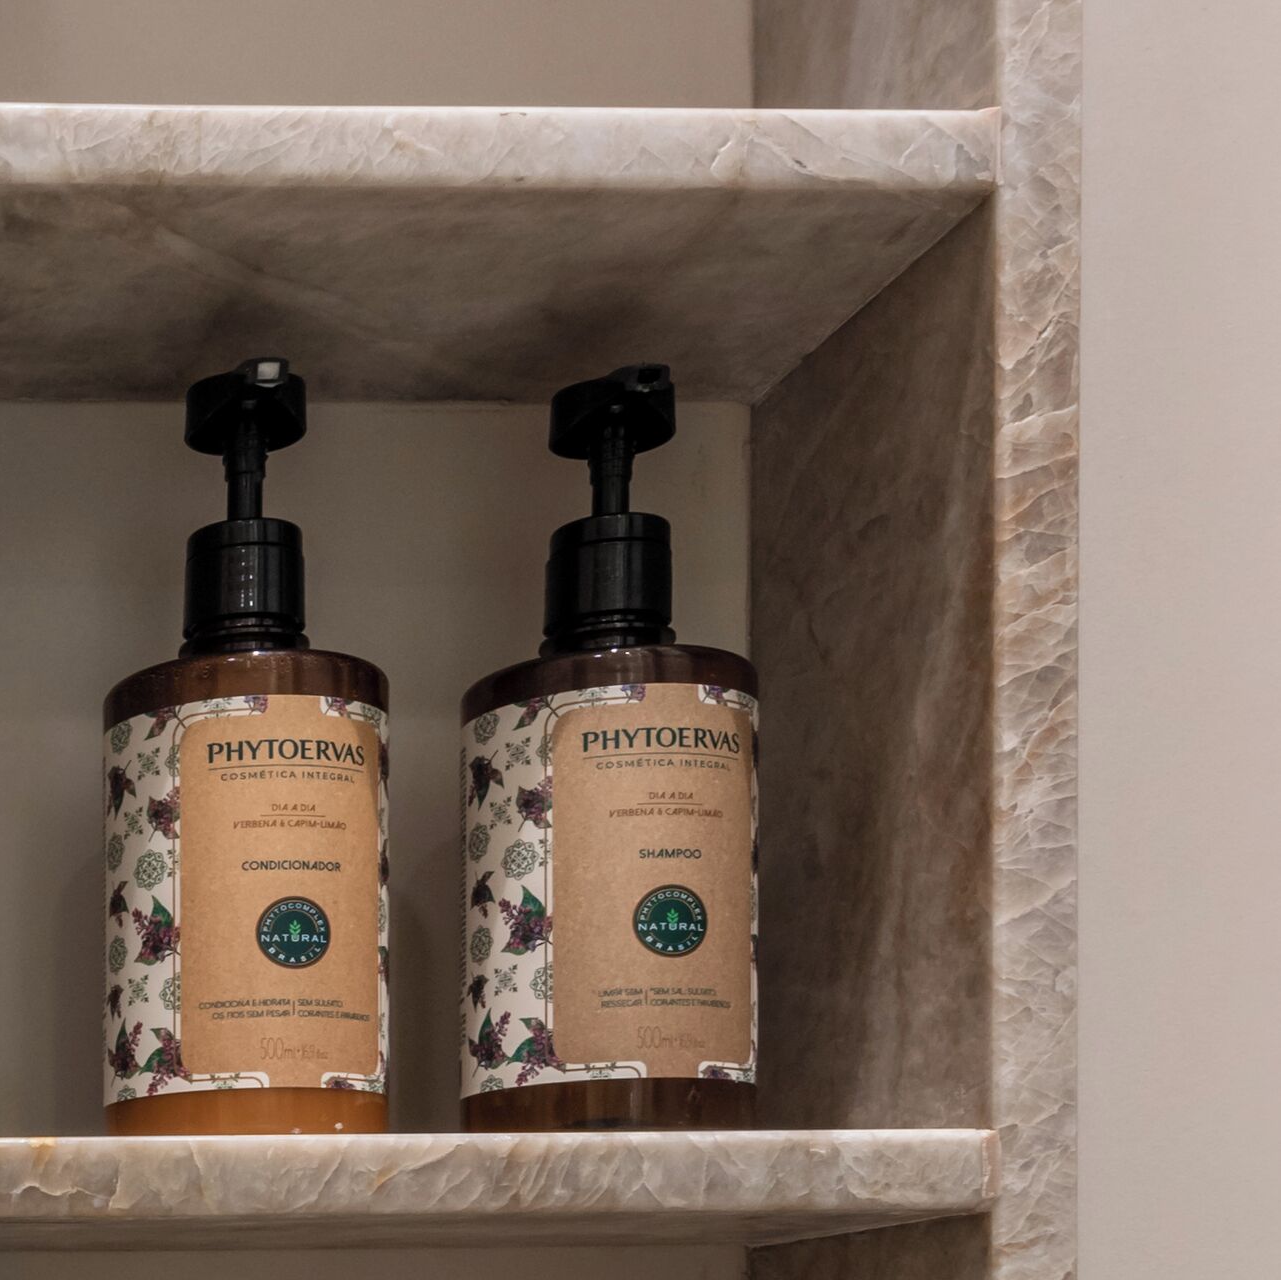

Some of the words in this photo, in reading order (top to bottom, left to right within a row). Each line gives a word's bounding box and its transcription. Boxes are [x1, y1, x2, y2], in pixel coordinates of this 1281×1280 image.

[582, 727, 740, 754] PHYTOERVAS
[207, 739, 365, 766] PHYTOERVAS
[596, 758, 674, 770] COSMÉTICA
[680, 759, 730, 771] INTEGRAL
[220, 770, 297, 782] COSMÉTICA
[302, 772, 355, 783] INTEGRAL
[649, 792, 666, 800] DIA
[668, 792, 676, 800] A
[678, 792, 694, 800] DIA
[272, 803, 288, 812] DIA
[291, 803, 298, 812] A
[300, 803, 316, 812] DIA
[609, 808, 654, 818] VERBENA
[233, 820, 277, 830] VERBENA
[639, 848, 702, 860] SHAMPOO
[242, 860, 341, 872] CONDICIONADOR
[640, 891, 702, 921] PHYTOCOMPLEX
[263, 902, 325, 932] PHYTOCOMPLEX
[638, 922, 704, 932] NATURAL
[261, 934, 327, 943] NATURAL
[645, 935, 699, 951] BRASIL
[268, 946, 321, 962] BRASIL
